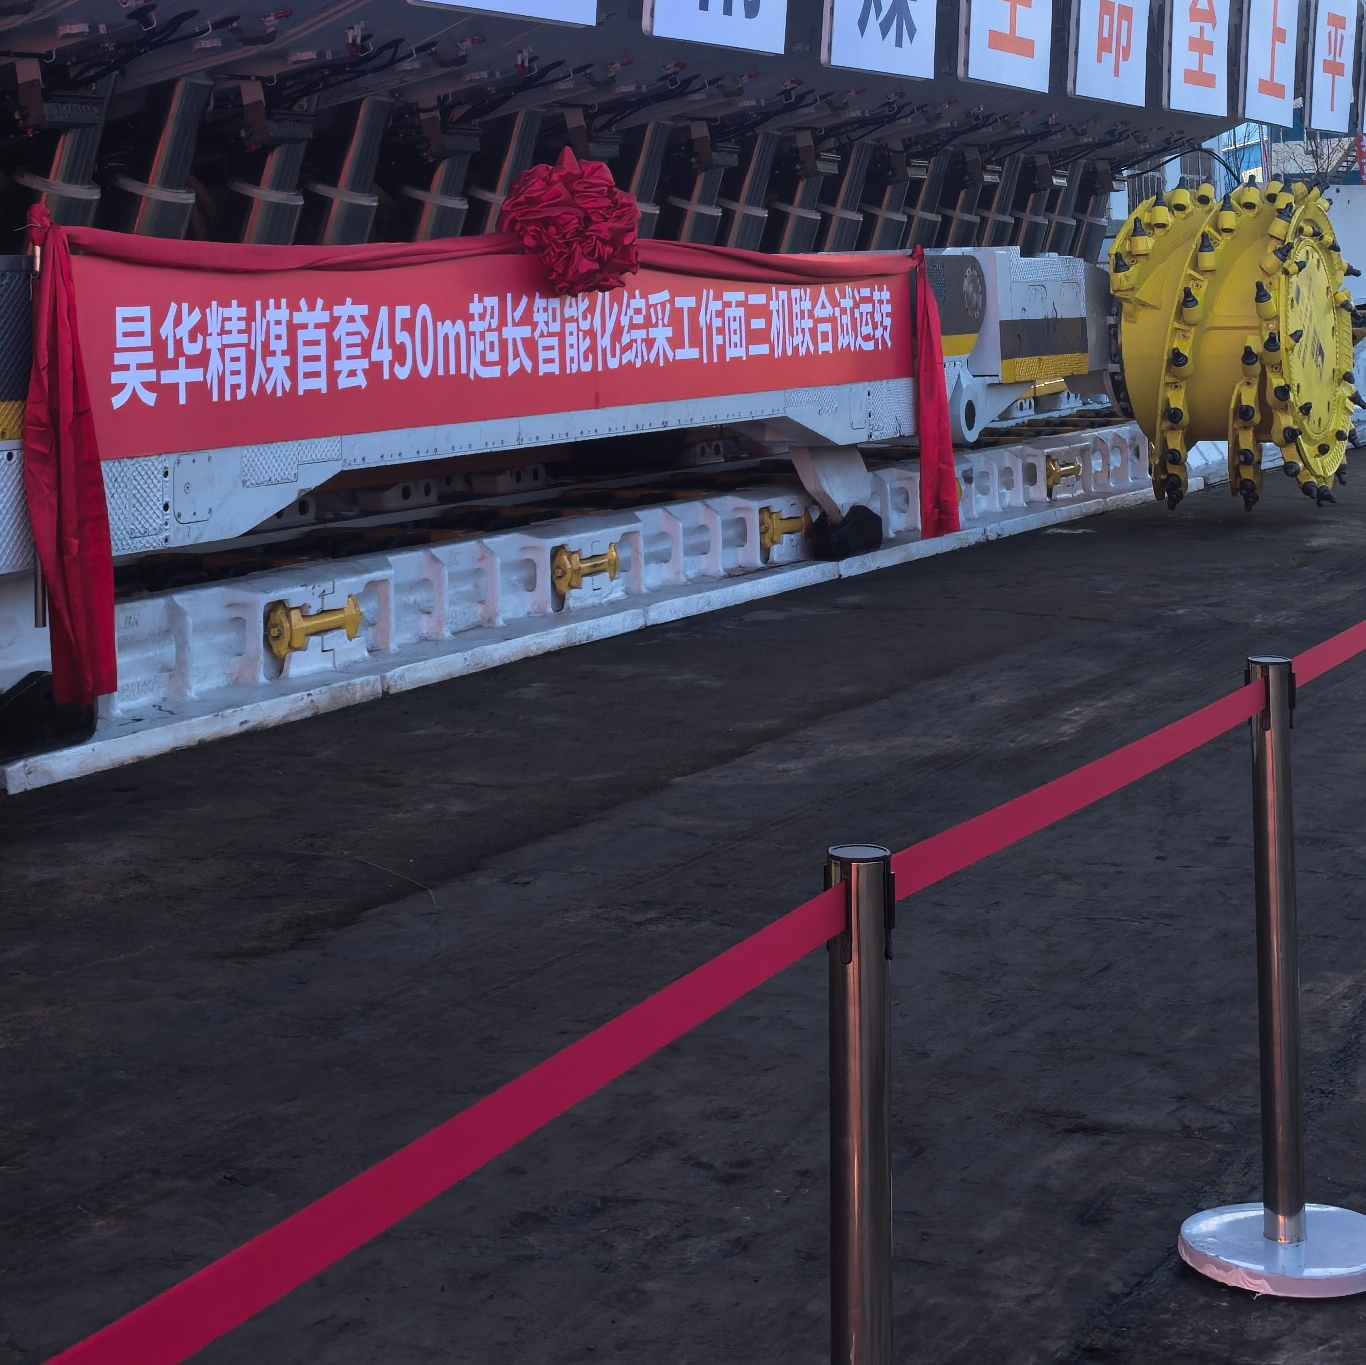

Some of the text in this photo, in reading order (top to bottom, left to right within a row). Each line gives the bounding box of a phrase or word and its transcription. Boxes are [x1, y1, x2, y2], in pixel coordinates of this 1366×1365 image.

[111, 285, 892, 410] 昊华精煤首套450m超长智能化综采工作面三机联合试运转
